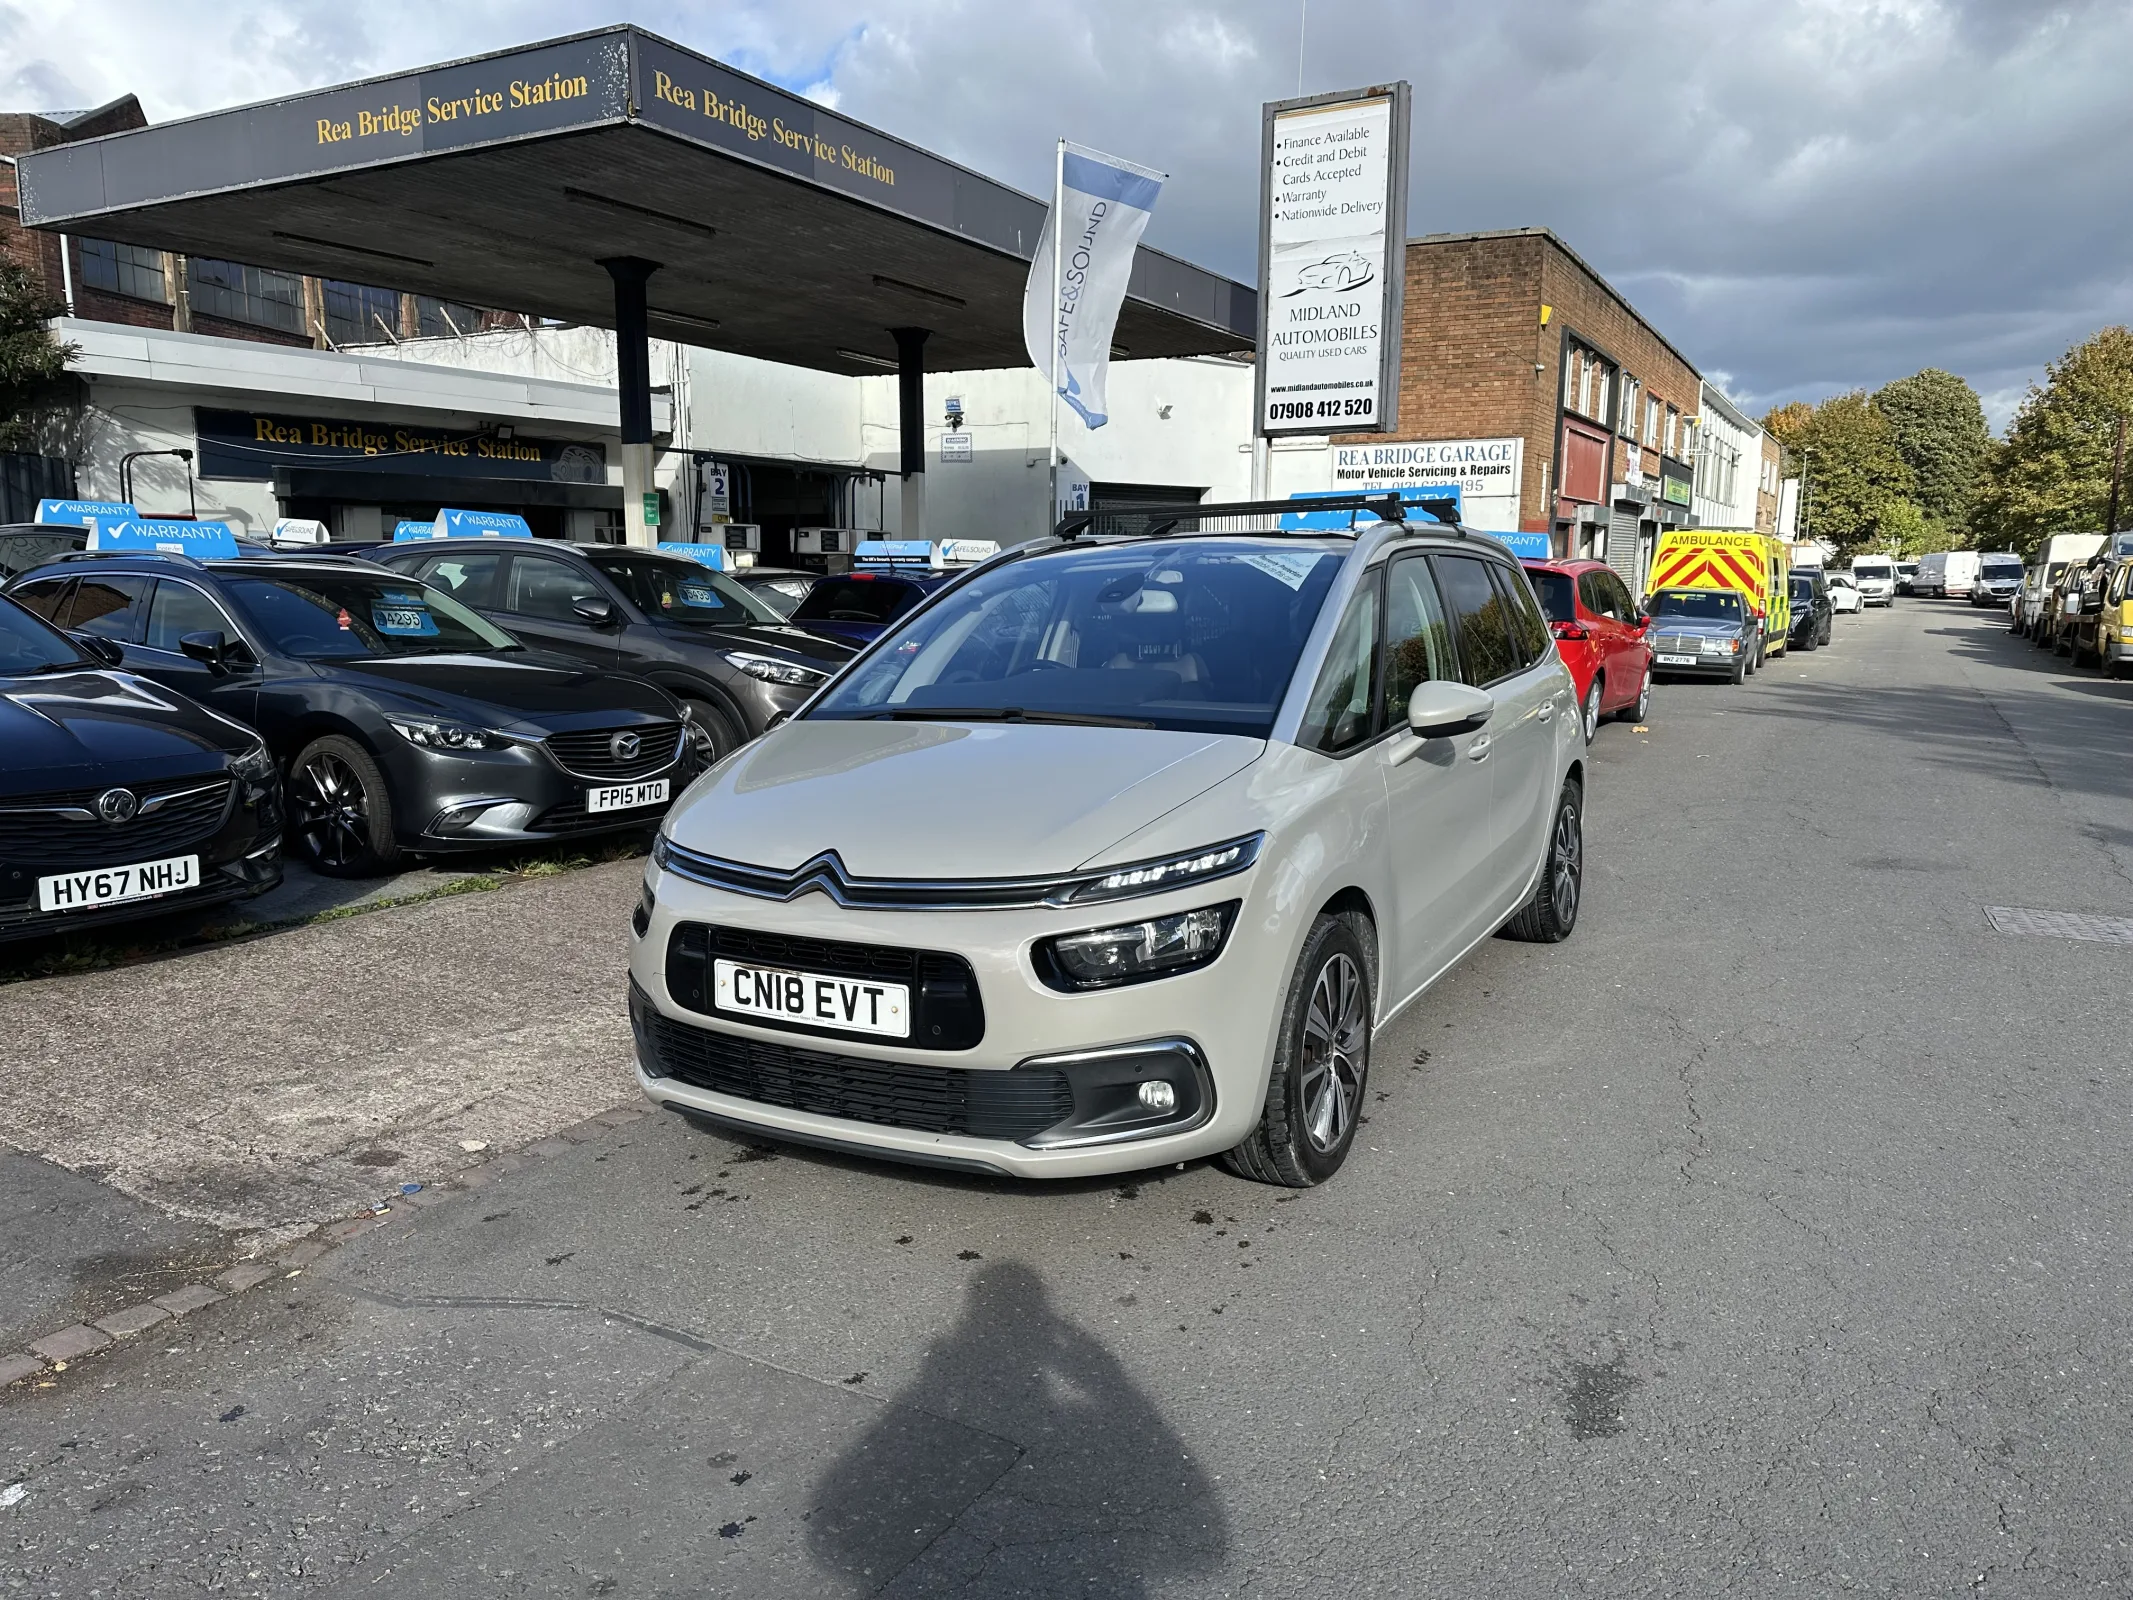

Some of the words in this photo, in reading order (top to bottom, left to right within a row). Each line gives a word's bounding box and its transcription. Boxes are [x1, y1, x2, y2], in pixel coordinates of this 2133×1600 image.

[316, 119, 351, 144] Rea
[358, 105, 421, 135] Bridge
[427, 88, 503, 123] Service
[509, 73, 588, 108] Station
[653, 69, 696, 111] Rea
[702, 89, 767, 141] Bridge
[773, 118, 836, 163] Service
[841, 144, 895, 185] Station
[1284, 136, 1321, 149] Finance
[1324, 127, 1370, 143] Available
[1283, 154, 1313, 167] Credit
[1317, 149, 1335, 163] and
[1339, 146, 1367, 159] Debit
[1283, 172, 1311, 185] Cards
[1313, 164, 1361, 182] Accepted
[1282, 189, 1327, 203] Warranty
[1282, 204, 1337, 221] Nationwide
[1341, 201, 1383, 214] Delivery
[1290, 303, 1361, 322] MIDLAND
[1271, 324, 1378, 346] AUTOMOBILES
[1279, 350, 1316, 361] QUALITY
[1318, 348, 1341, 357] USED
[1344, 346, 1367, 355] CARS
[1271, 380, 1373, 393] www.midlandautomobiles.co.uk
[1270, 402, 1314, 420] 07908
[1317, 400, 1341, 417] 412
[1344, 398, 1372, 416] 520
[254, 418, 302, 445] Rea
[311, 423, 388, 456] Bridge
[395, 430, 469, 457] Service
[477, 438, 541, 461] Station
[1338, 450, 1369, 466] REA
[1374, 446, 1436, 465] BRIDGE
[1440, 444, 1512, 462] GARAGE
[710, 468, 727, 477] BAY
[1337, 468, 1365, 480] Motor
[1368, 466, 1405, 479] Vehicle
[1408, 465, 1457, 478] Servicing
[1460, 467, 1467, 476] &
[1470, 463, 1511, 477] Repairs
[715, 478, 724, 495] 2
[65, 503, 131, 516] WARRANTY
[1075, 493, 1084, 509] 1
[464, 514, 522, 529] WARRANTY
[130, 524, 222, 540] WARRANTY
[1495, 535, 1543, 546] RRANTY
[1670, 536, 1752, 547] AMBULANCE
[672, 547, 717, 558] WARRANTY
[600, 786, 634, 807] FP15
[637, 783, 662, 802] MTO
[53, 870, 130, 905] HY67
[139, 861, 189, 891] NHJ
[733, 969, 804, 1013] CN18
[815, 980, 884, 1025] EVT
